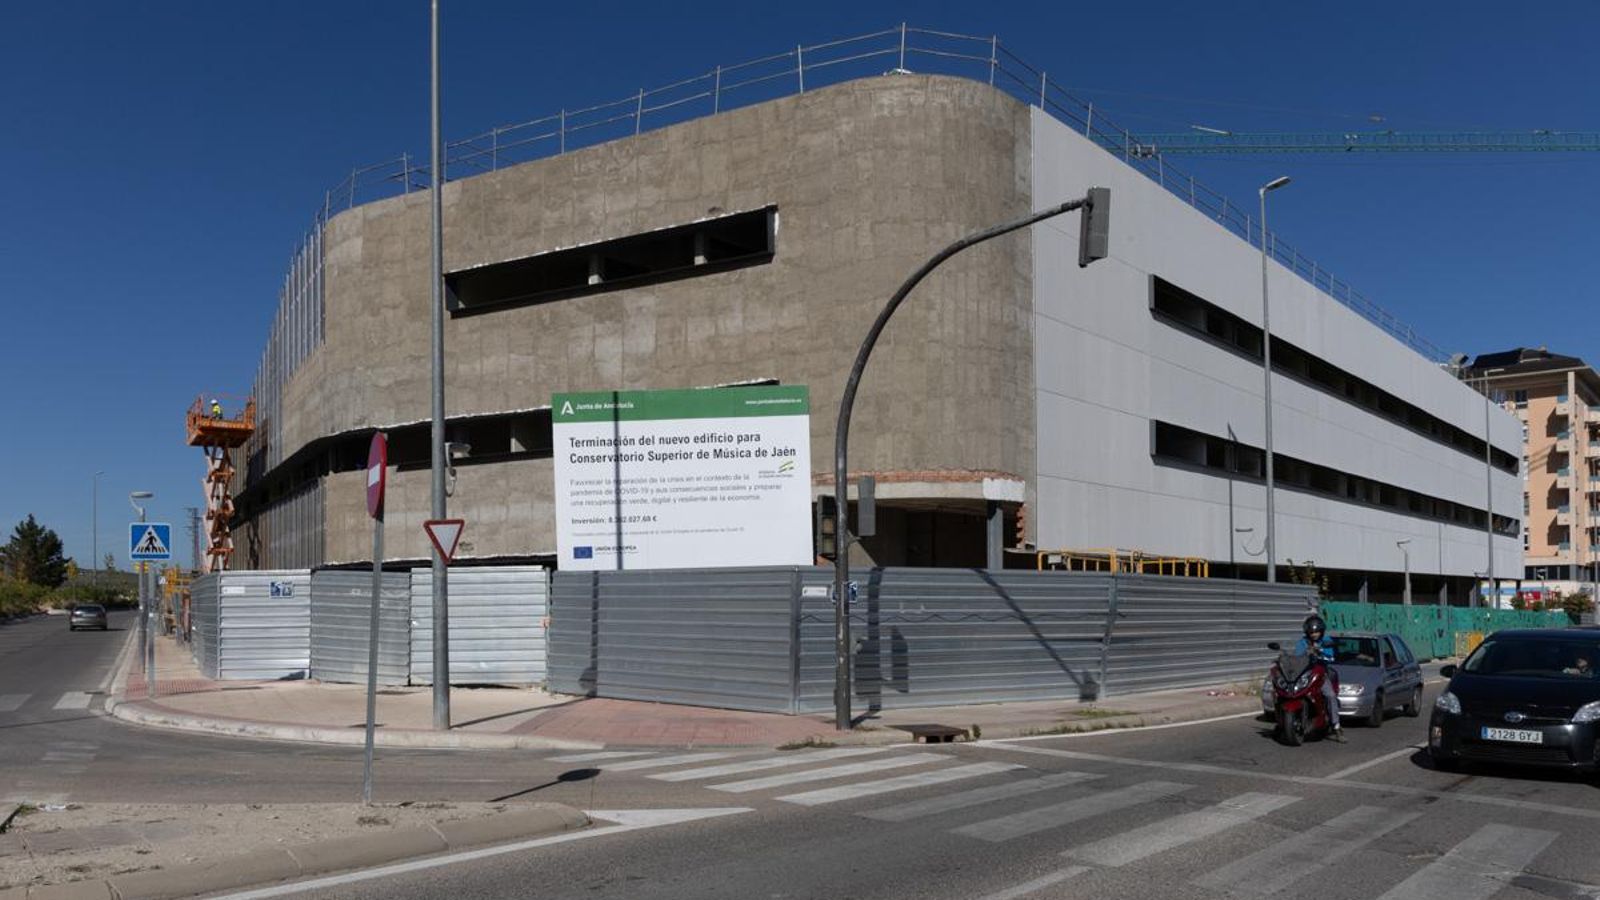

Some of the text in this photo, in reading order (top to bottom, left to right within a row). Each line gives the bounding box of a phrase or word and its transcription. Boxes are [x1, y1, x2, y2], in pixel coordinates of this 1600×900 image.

[569, 432, 761, 448] Terminación del nuevo edificio para
[569, 446, 797, 464] Conservatorio Superior de Música de Jaén
[1490, 729, 1516, 740] 2128
